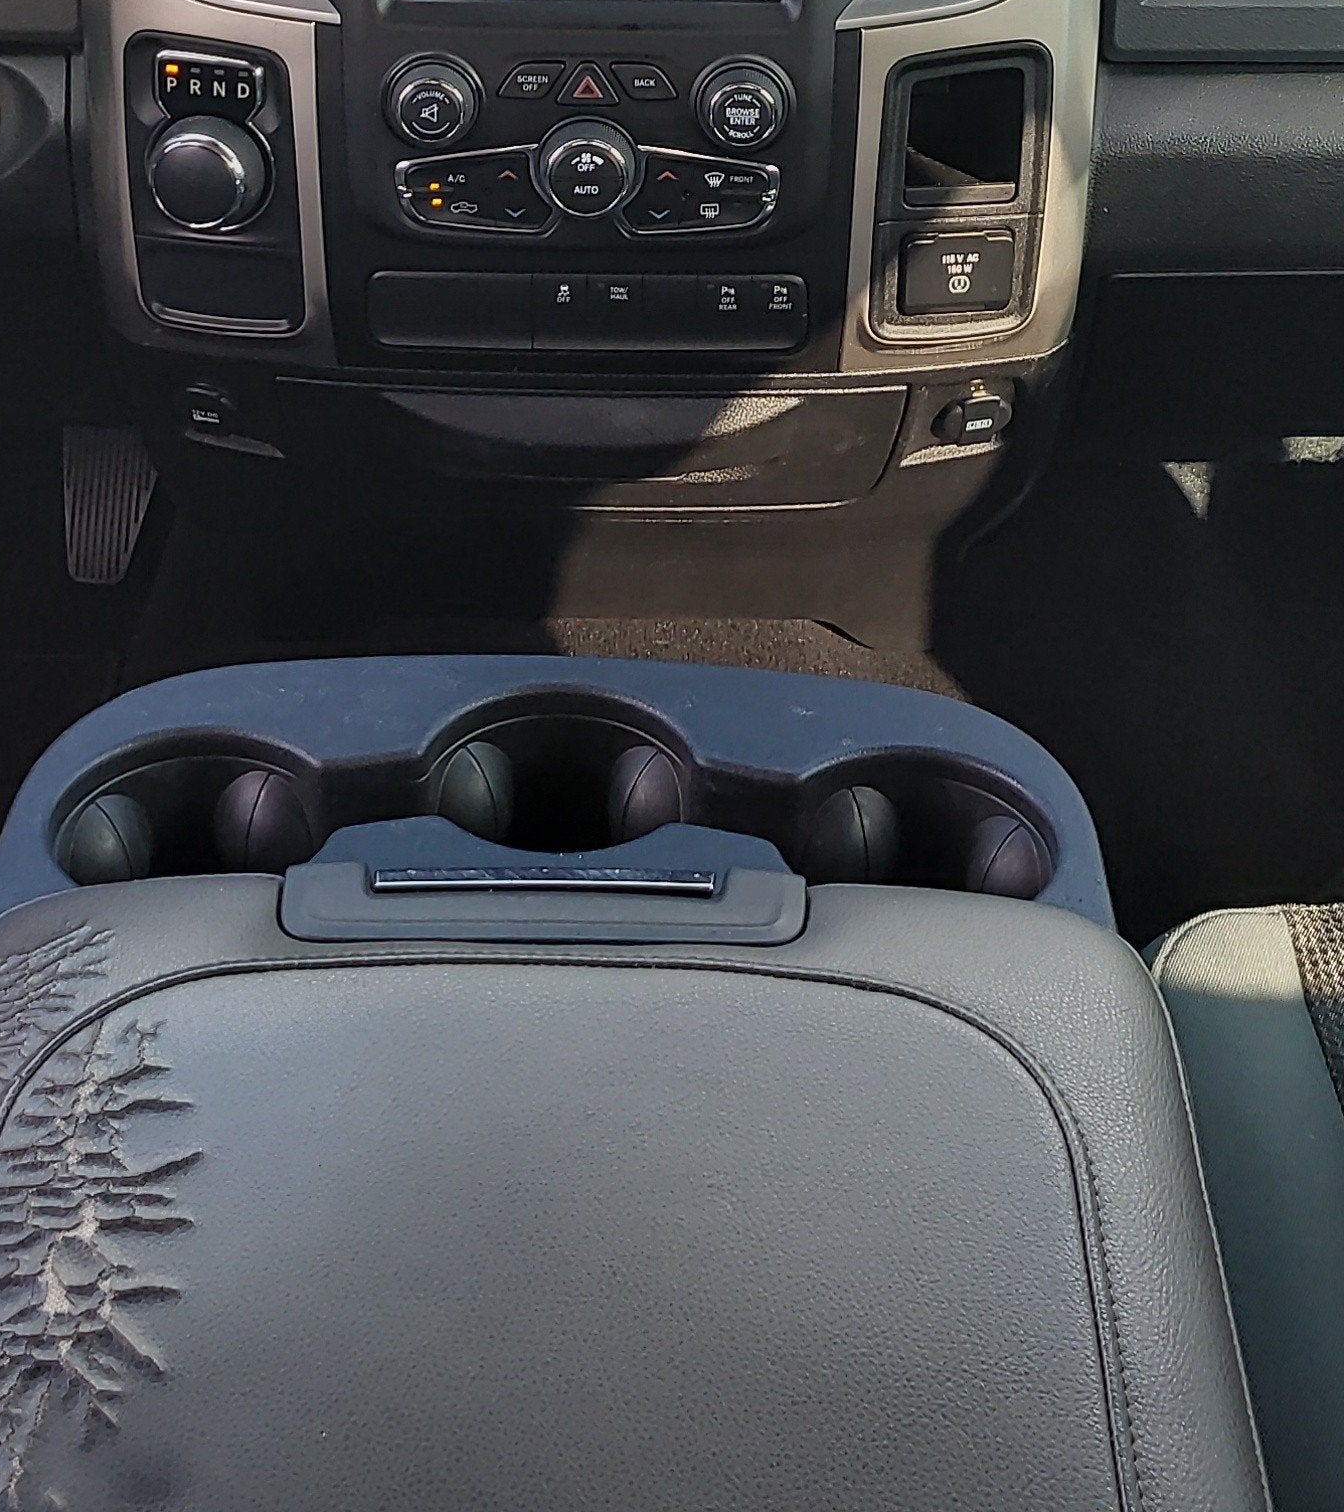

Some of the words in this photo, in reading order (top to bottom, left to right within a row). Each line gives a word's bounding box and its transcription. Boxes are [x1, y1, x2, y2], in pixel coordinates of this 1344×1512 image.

[516, 75, 549, 84] SCREEN
[634, 78, 656, 87] BACK
[166, 77, 177, 93] P
[189, 79, 201, 96] R
[213, 81, 226, 98] N
[237, 82, 250, 99] D
[522, 83, 538, 91] OFF
[416, 90, 445, 100] VOLUME
[733, 93, 753, 103] TUNE
[725, 107, 760, 117] BROWSE
[729, 116, 756, 125] ENTER
[728, 129, 755, 139] SCROLL
[577, 163, 595, 172] OFF
[447, 173, 466, 183] A/C
[729, 175, 754, 184] FRONT
[573, 185, 599, 195] AUTO
[718, 303, 737, 311] REAR
[768, 302, 793, 311] FRONT
